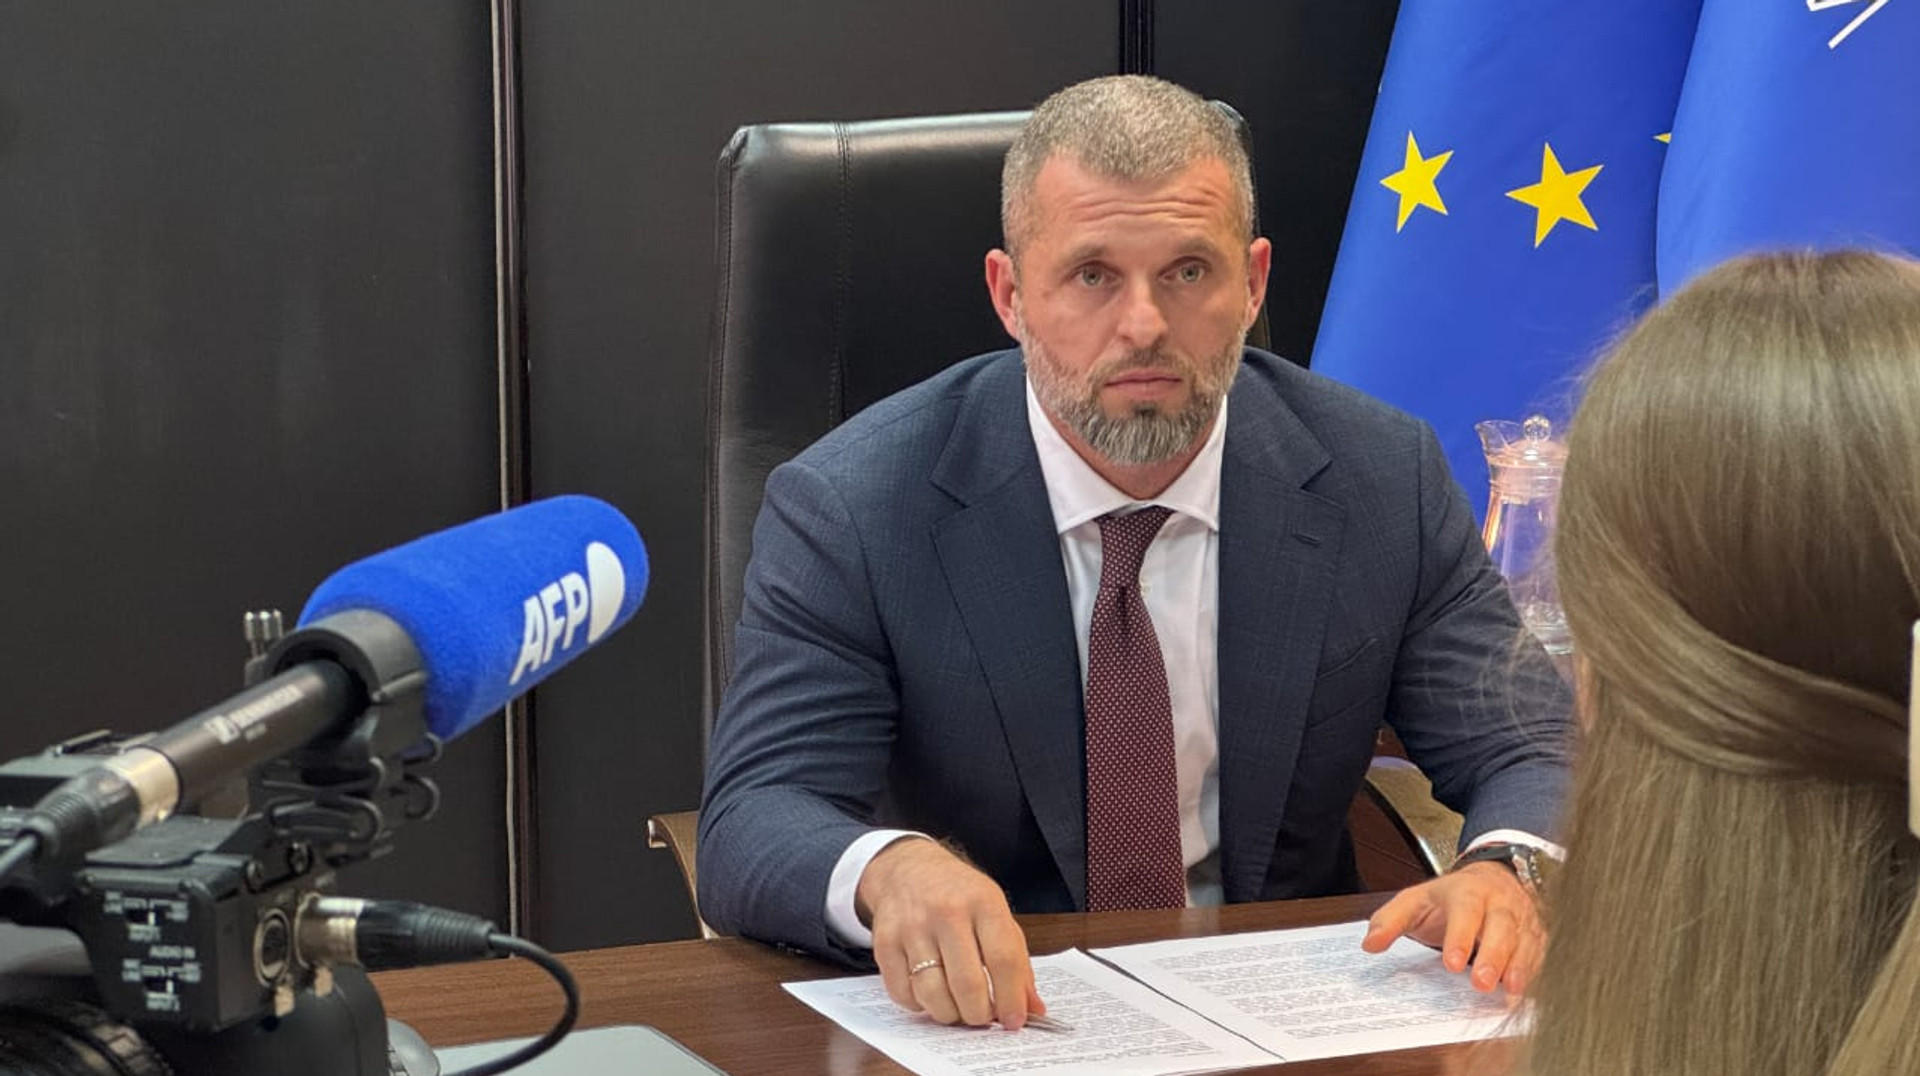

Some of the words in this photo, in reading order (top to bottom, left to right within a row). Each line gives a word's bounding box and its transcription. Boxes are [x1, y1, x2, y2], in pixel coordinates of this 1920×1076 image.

[509, 571, 589, 686] AFP
[150, 946, 182, 959] AUDIO
[183, 947, 196, 960] IN
